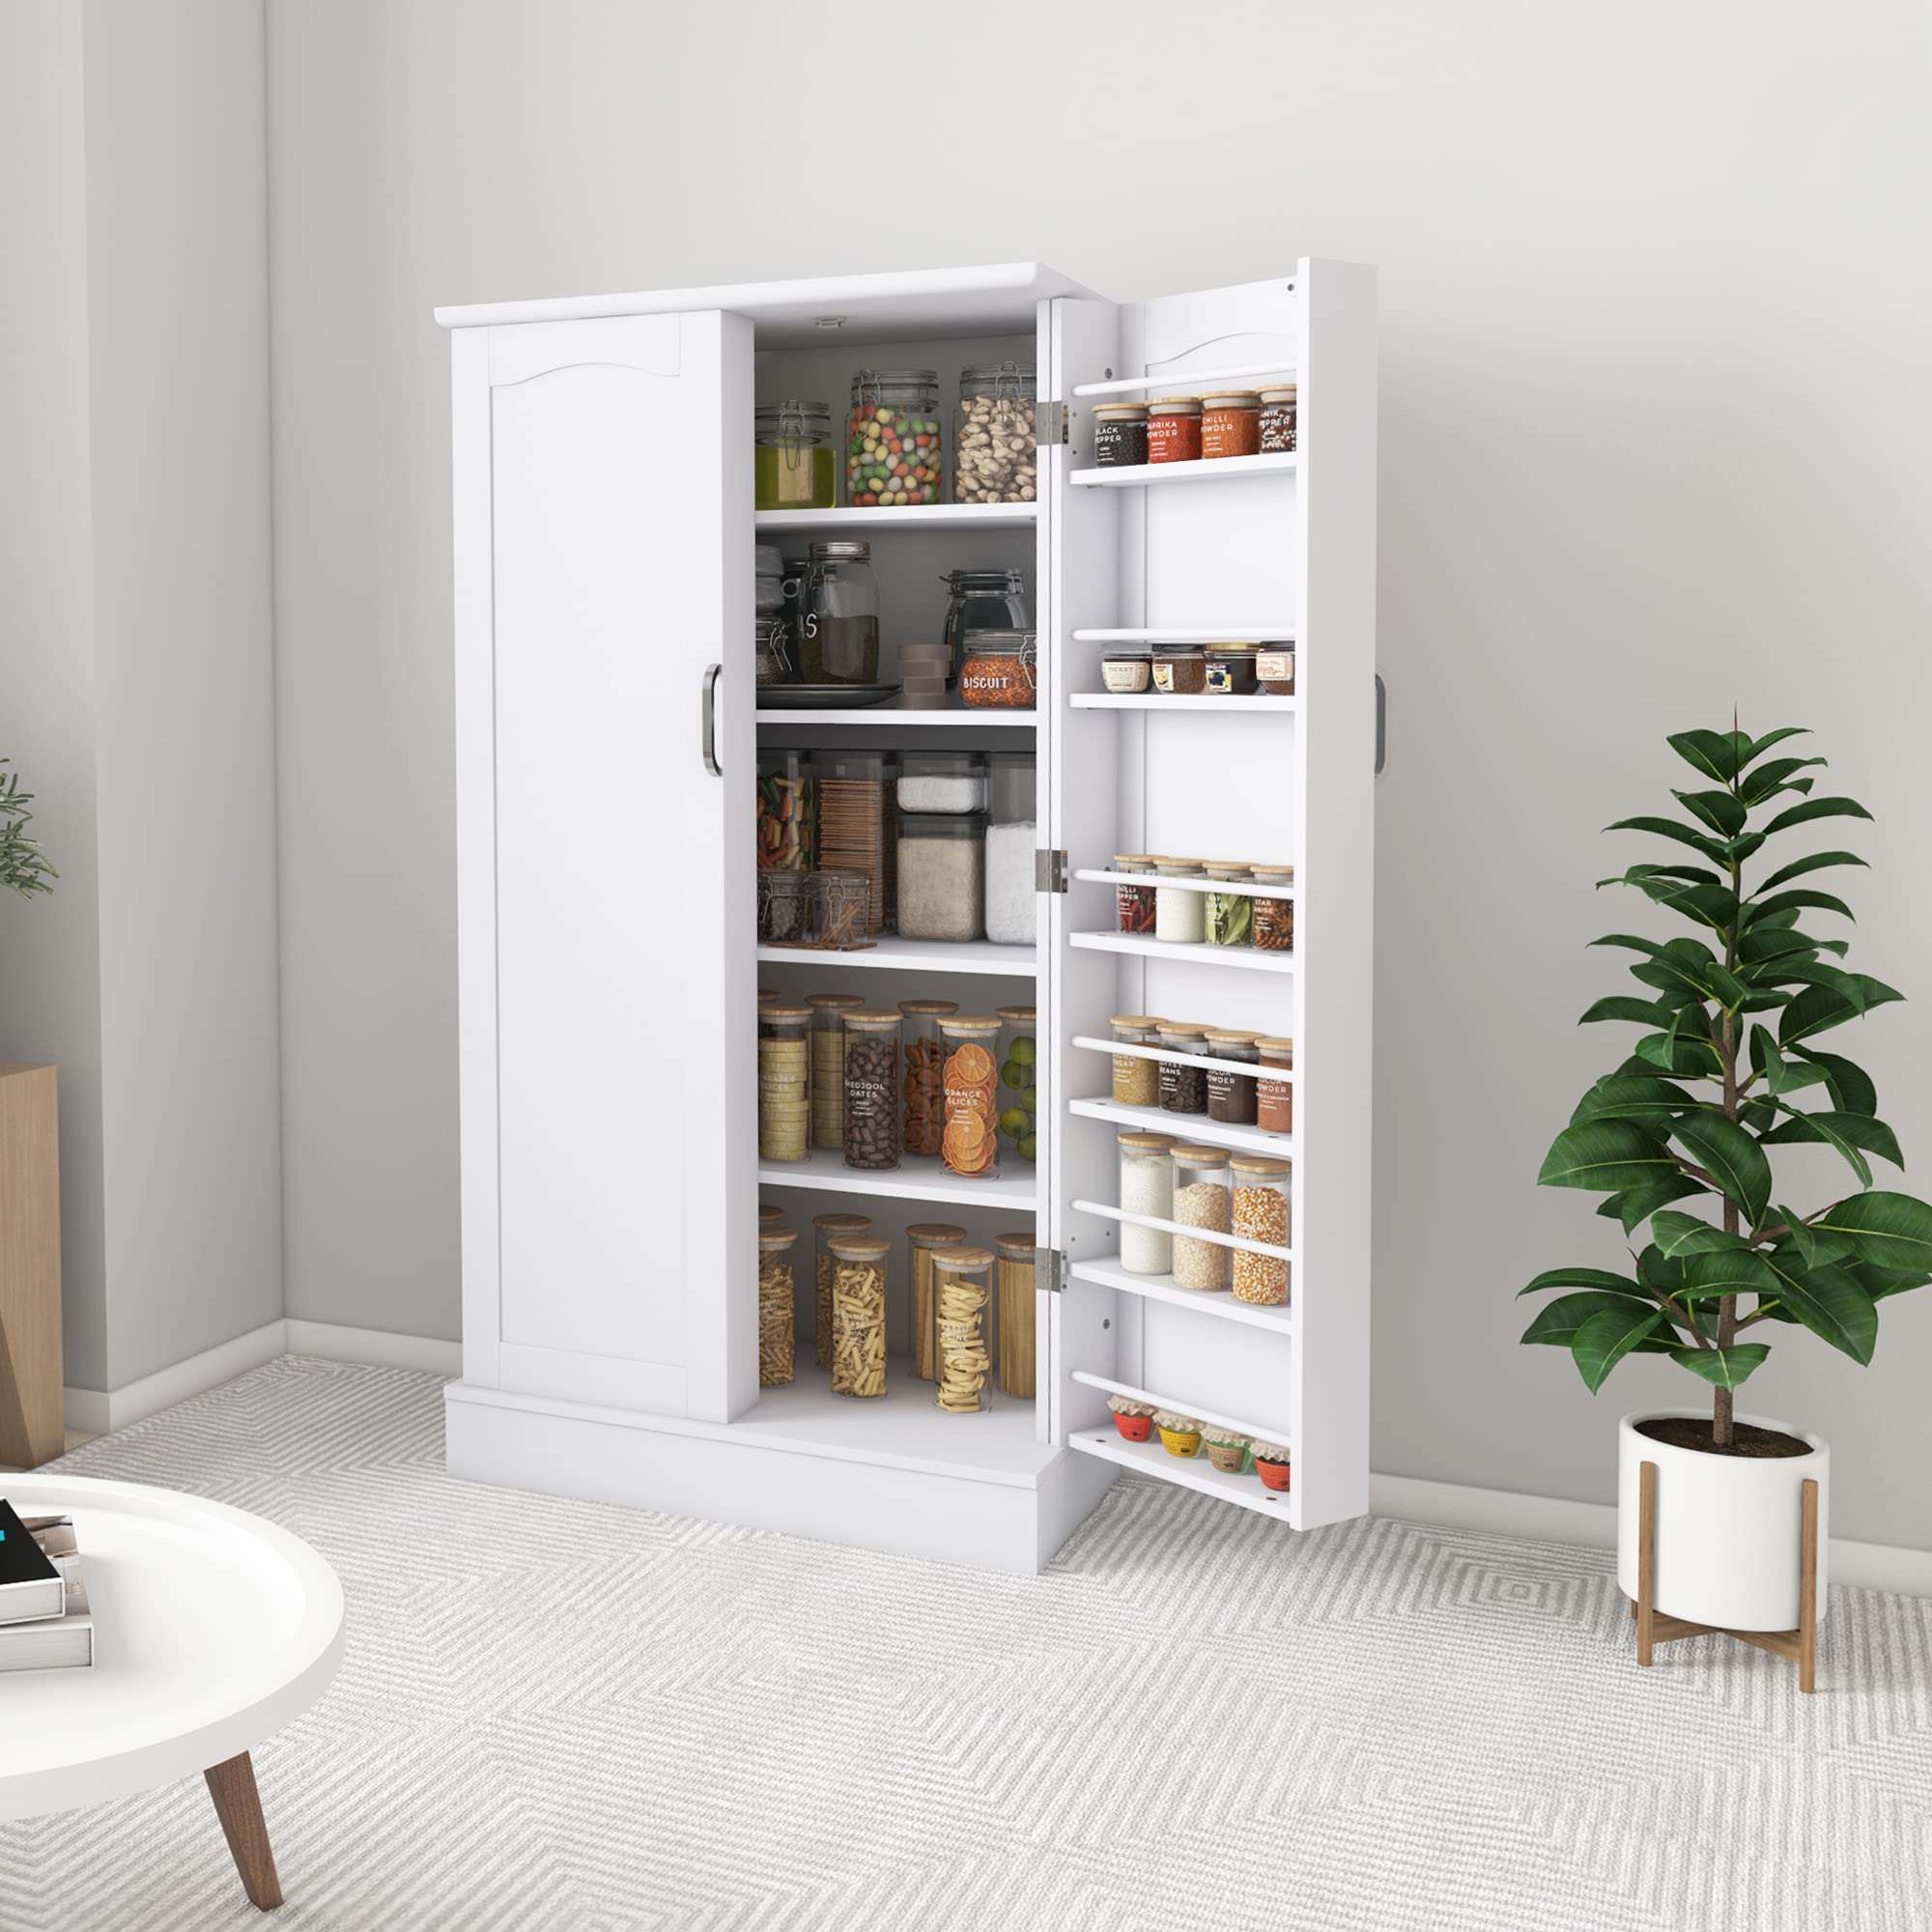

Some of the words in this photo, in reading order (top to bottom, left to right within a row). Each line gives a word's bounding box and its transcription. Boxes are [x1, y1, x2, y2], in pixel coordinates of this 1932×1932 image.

[963, 676, 1009, 689] BISCUIT
[850, 1090, 877, 1098] DATES
[945, 1088, 981, 1098] ORANGE
[948, 1096, 978, 1107] SLICES
